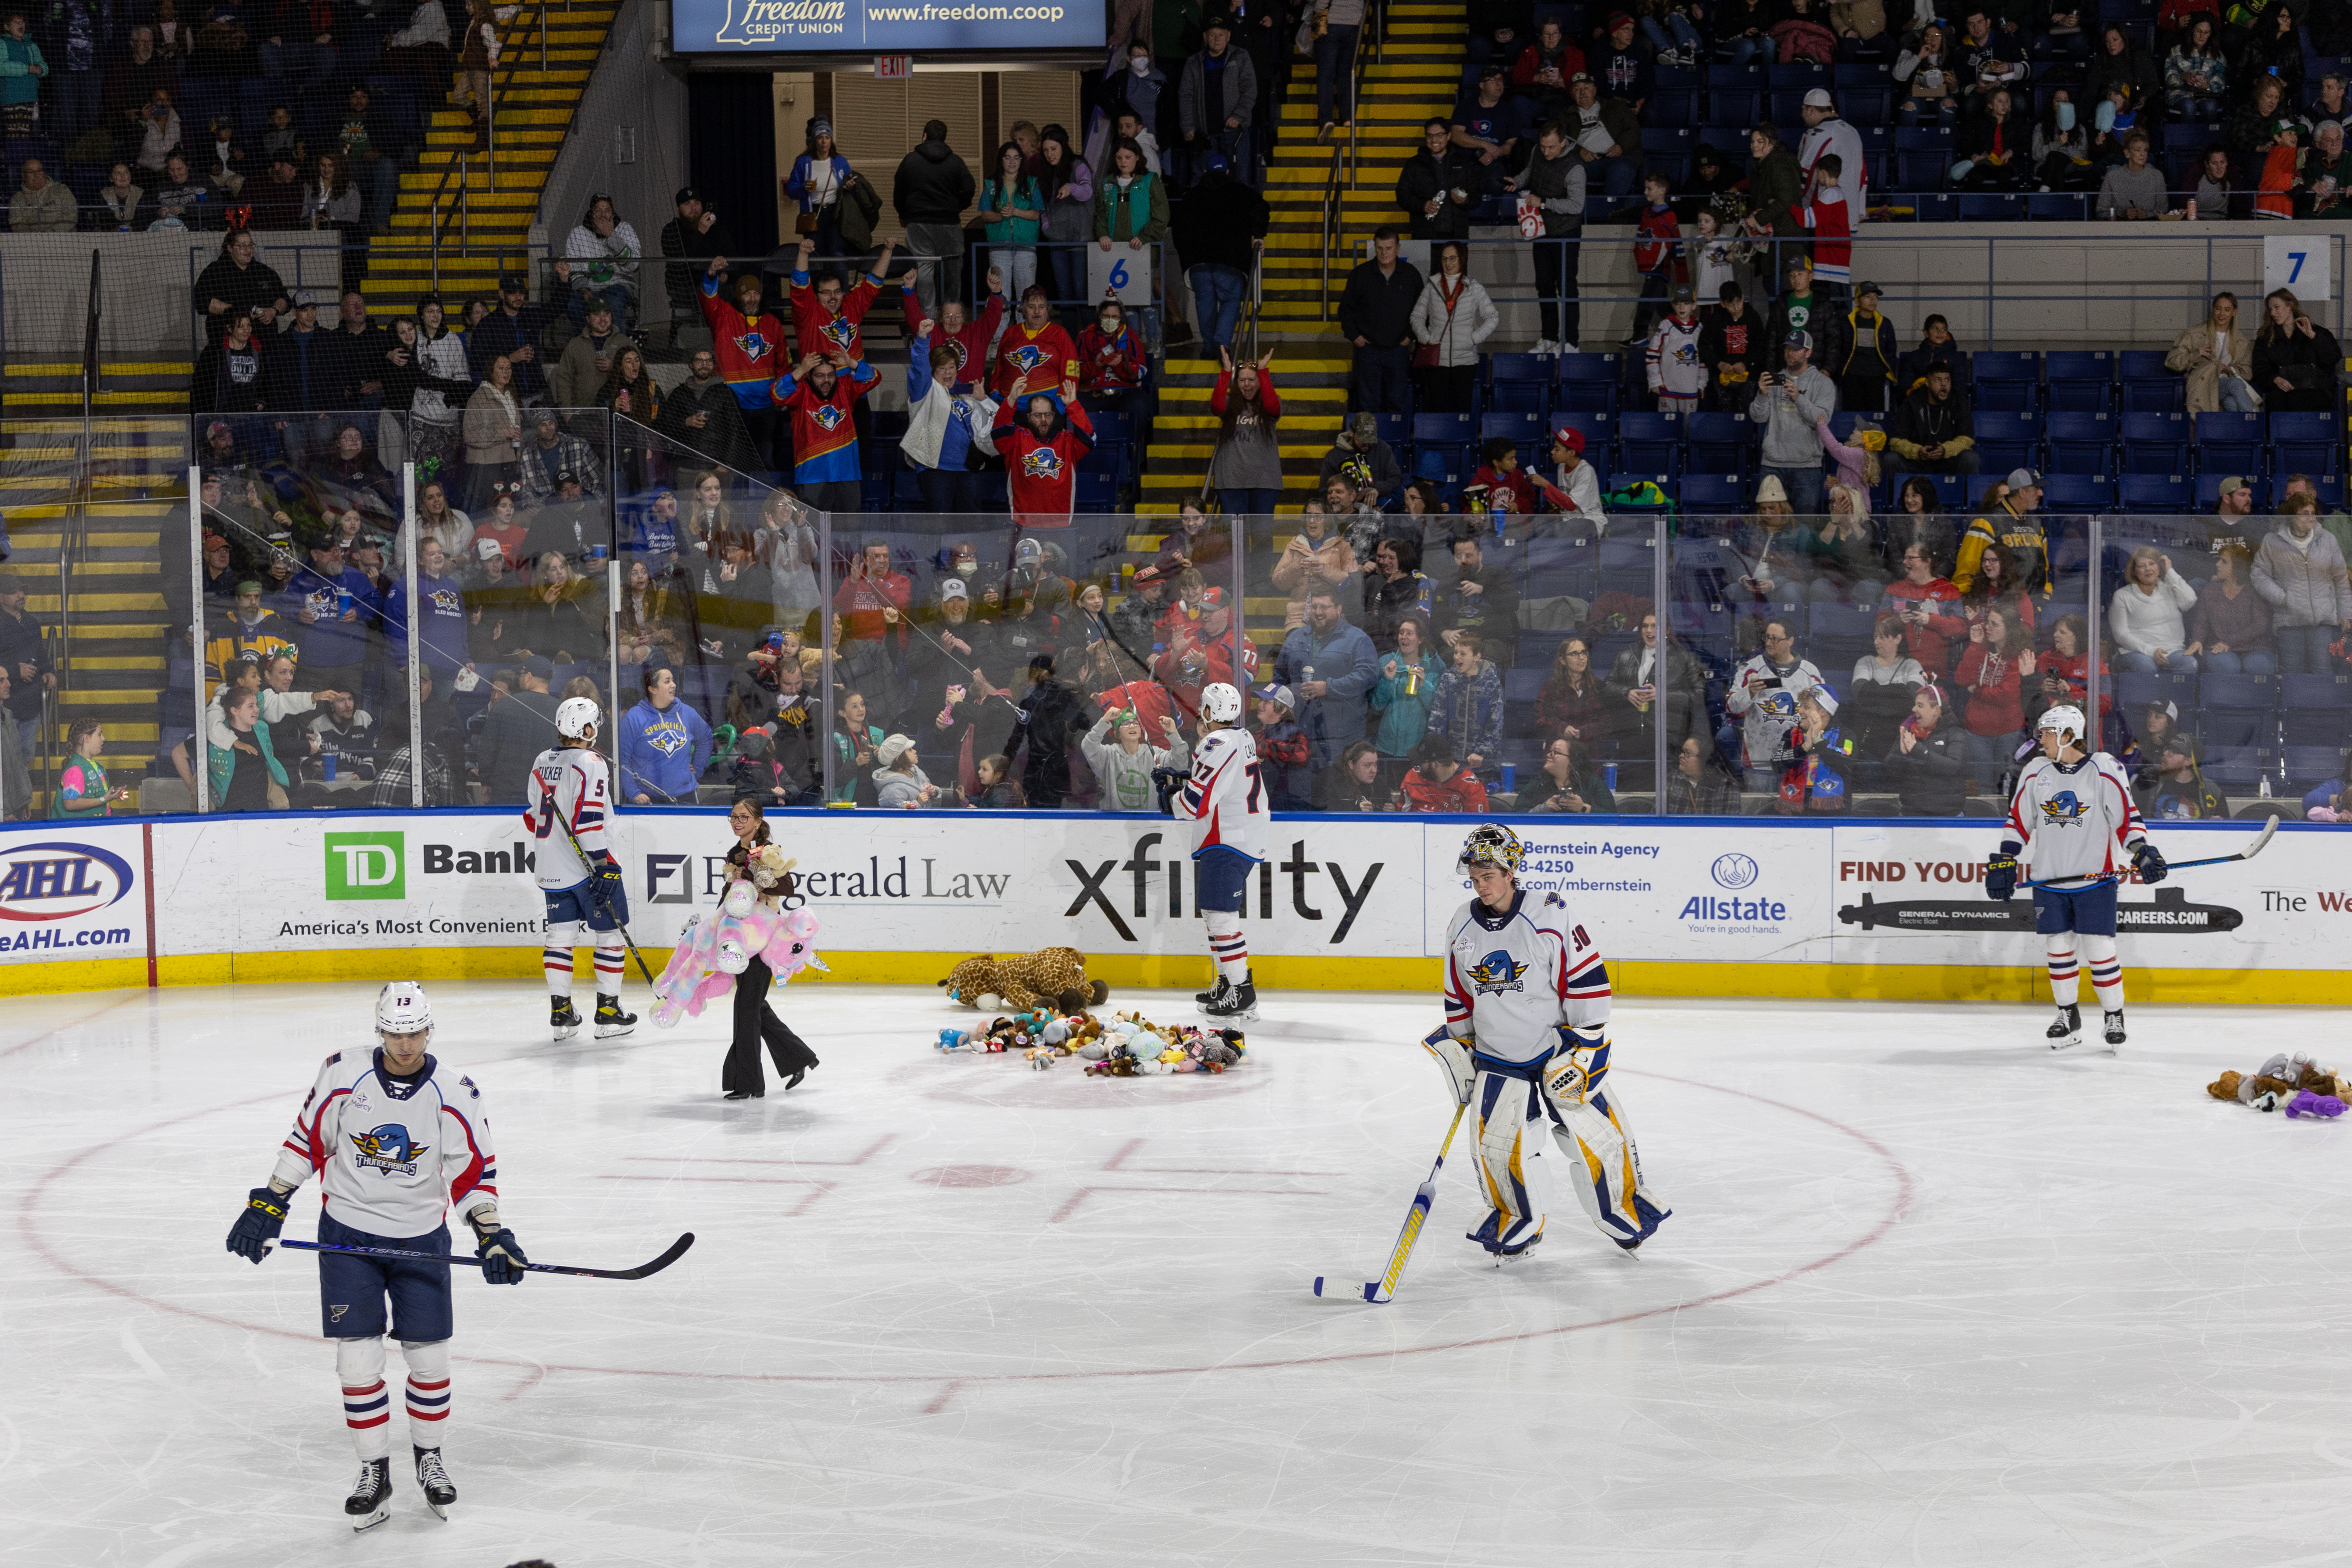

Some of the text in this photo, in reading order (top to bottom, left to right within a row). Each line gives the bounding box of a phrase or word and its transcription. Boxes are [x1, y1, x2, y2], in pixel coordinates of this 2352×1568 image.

[869, 4, 1064, 22] www.freedom.coop
[746, 23, 843, 35] CREDIT UNION
[882, 56, 907, 75] EXIT
[1109, 259, 1129, 289] 6
[2288, 253, 2307, 284] 7
[1419, 589, 1429, 601] 15
[1243, 650, 1257, 666] 77
[645, 722, 687, 736] SPRINGFIELD
[539, 766, 563, 781] TUCKER
[1194, 761, 1215, 782] 77
[595, 779, 604, 797] 5
[1245, 761, 1260, 814] 7
[2044, 817, 2083, 828] THUNDERBIRDS
[424, 842, 535, 873] Bank
[1524, 841, 1660, 859] Bernstein Agency
[333, 845, 397, 886] TD
[1840, 861, 1906, 882] FIND
[1988, 861, 2016, 870] CCM
[0, 856, 102, 902] AHL
[703, 855, 1011, 910] Fgerald Law
[1064, 832, 1385, 944] xfiity
[1463, 877, 1652, 892] ae.com/mbernstein
[1233, 889, 1242, 898] CC
[2260, 891, 2307, 911] The
[1679, 897, 1785, 921] Allstate
[280, 919, 369, 936] America's
[376, 918, 423, 934] Most
[429, 918, 536, 933] Convenient
[1688, 924, 1782, 936] You're in good hands.
[1571, 924, 1592, 953] 30
[1476, 981, 1523, 996] THUNDERBIRDS
[397, 997, 411, 1006] 13
[351, 1100, 372, 1112] Mercy
[1439, 1104, 1465, 1159] WARRIOR
[357, 1154, 417, 1177] THUNDERBIRDS
[1631, 1139, 1644, 1187] TRUE
[1472, 1157, 1488, 1203] TRUE
[350, 1246, 421, 1257] JETSPEED
[1382, 1207, 1424, 1296] WARRIOR
